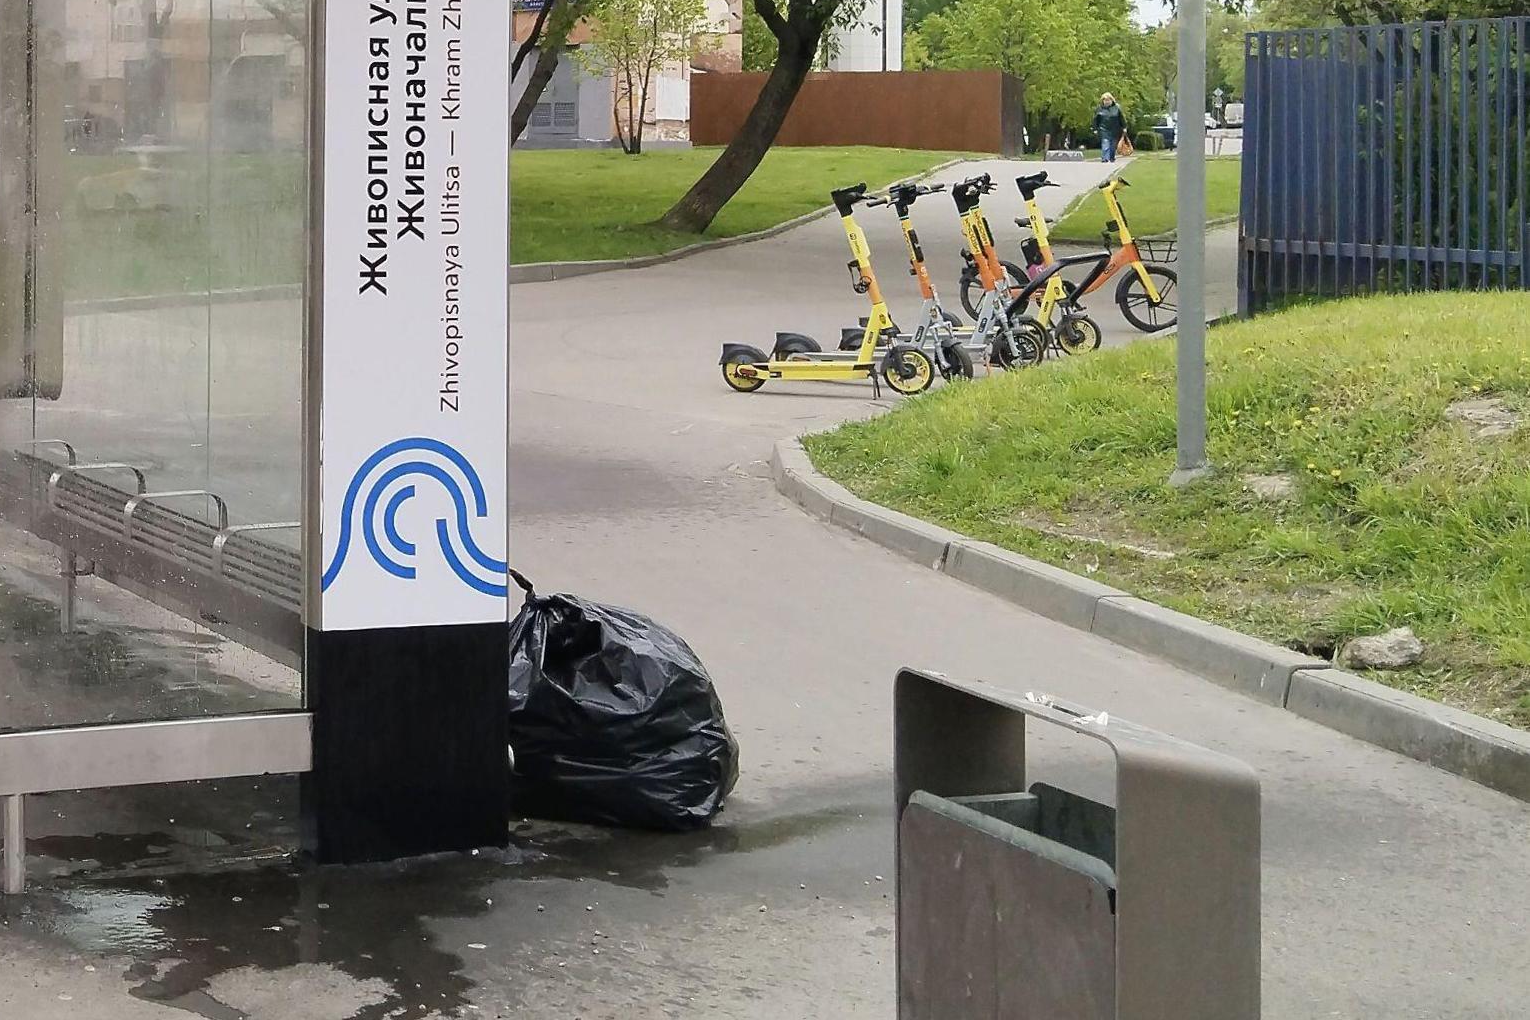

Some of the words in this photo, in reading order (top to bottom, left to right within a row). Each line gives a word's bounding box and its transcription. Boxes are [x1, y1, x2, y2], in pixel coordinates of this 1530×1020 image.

[441, 40, 462, 120] Khram
[359, 38, 390, 295] Живописная
[440, 166, 460, 235] Ulitsa
[440, 246, 464, 412] Zhivopisnaya
